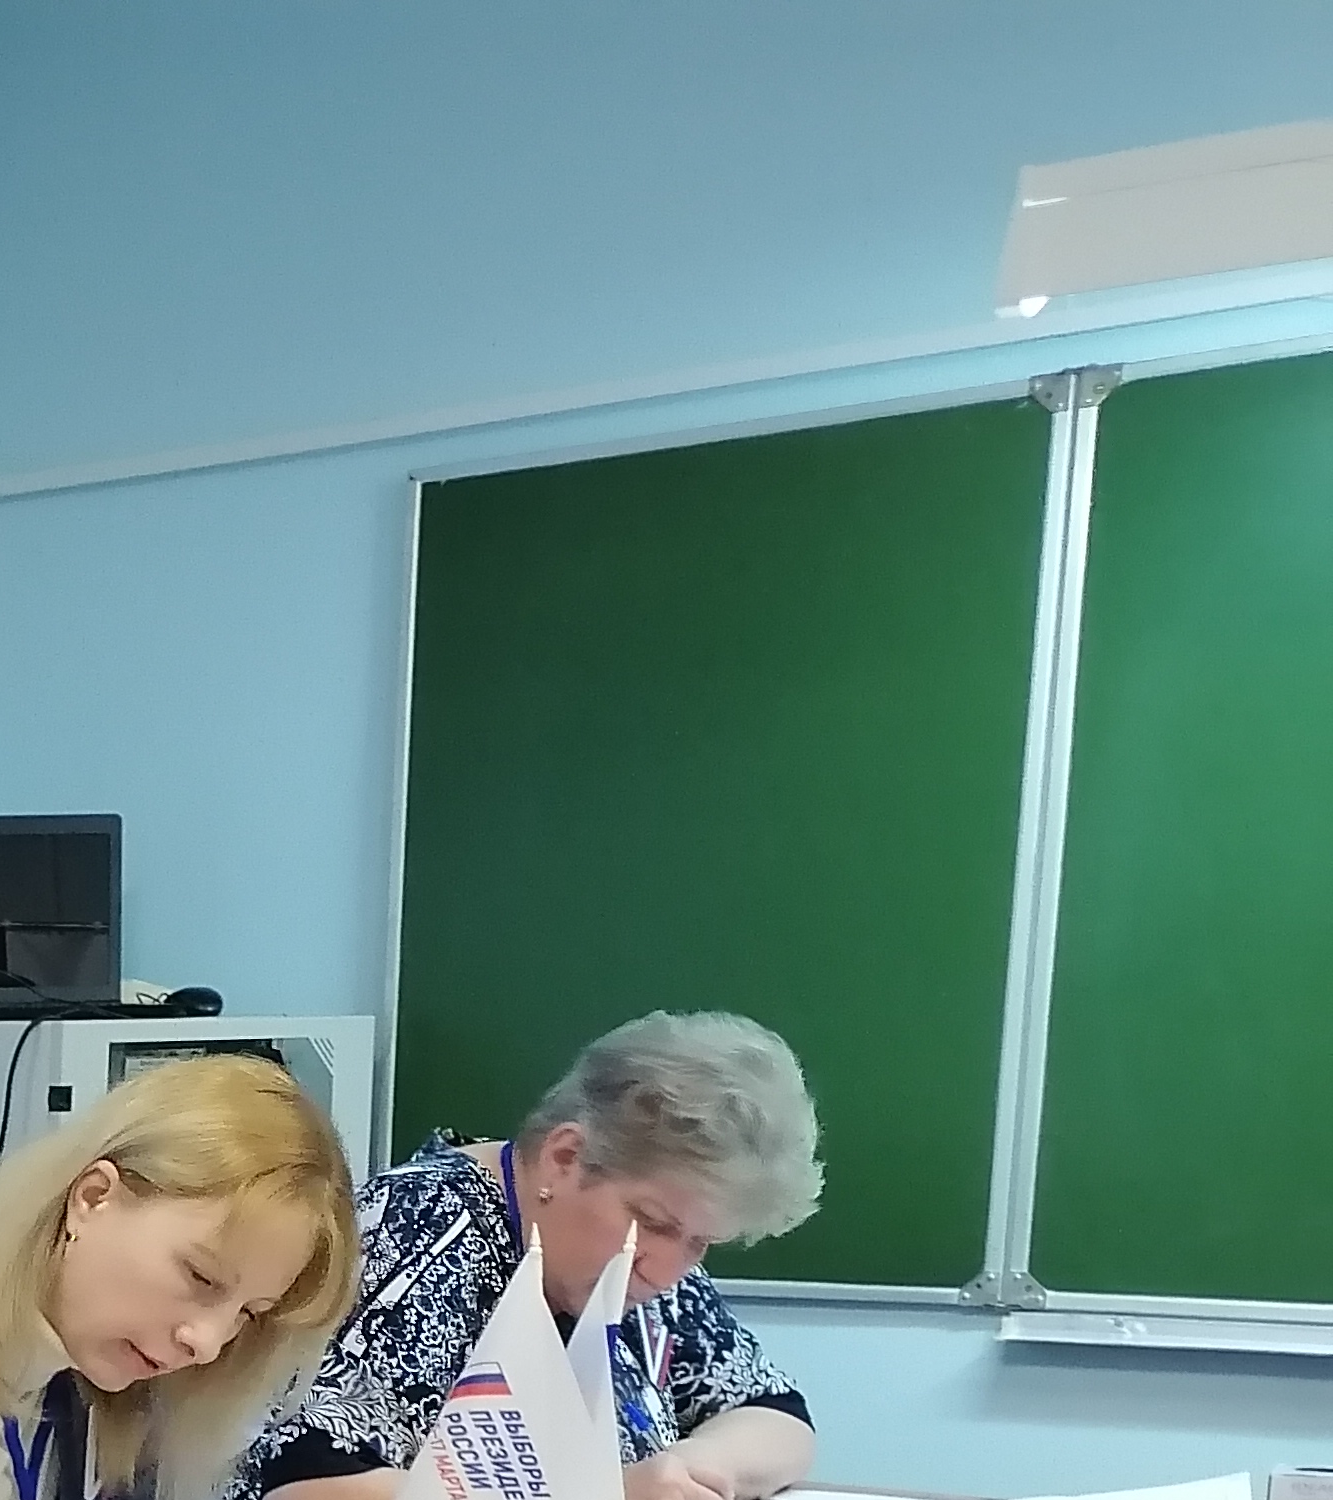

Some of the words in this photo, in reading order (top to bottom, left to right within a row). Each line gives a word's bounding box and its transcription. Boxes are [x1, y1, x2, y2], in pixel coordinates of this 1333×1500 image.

[434, 1454, 468, 1500] МАРТА
[443, 1412, 493, 1489] РОССИИ
[499, 1409, 552, 1498] ВЫБОРЫ
